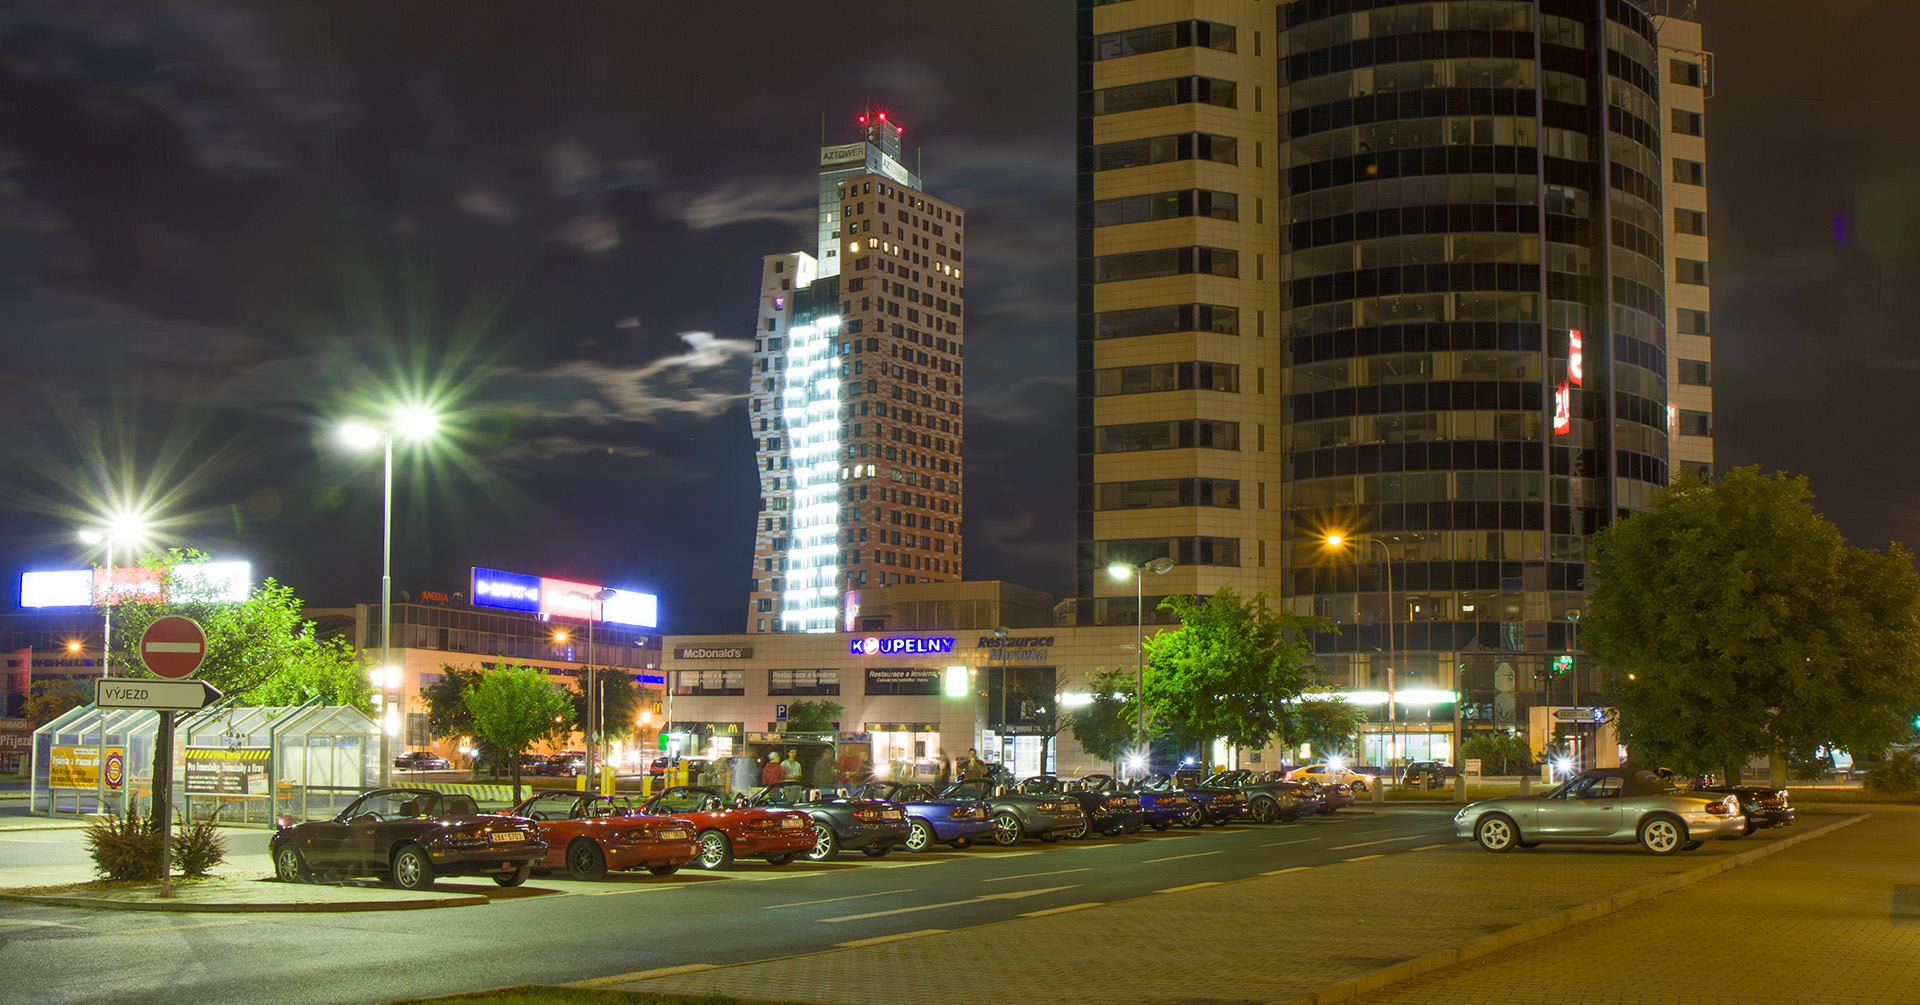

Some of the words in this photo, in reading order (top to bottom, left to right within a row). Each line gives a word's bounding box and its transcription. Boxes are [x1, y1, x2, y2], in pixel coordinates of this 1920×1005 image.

[422, 591, 449, 602] MEDIA
[851, 637, 955, 655] KOUPELNY
[978, 637, 1055, 648] Restaurace
[683, 648, 743, 658] McDonald's
[773, 671, 806, 679] Restaurace
[869, 670, 905, 678] Restaurace
[105, 687, 149, 700] VÝJEZD
[0, 733, 32, 748] Příjezd
